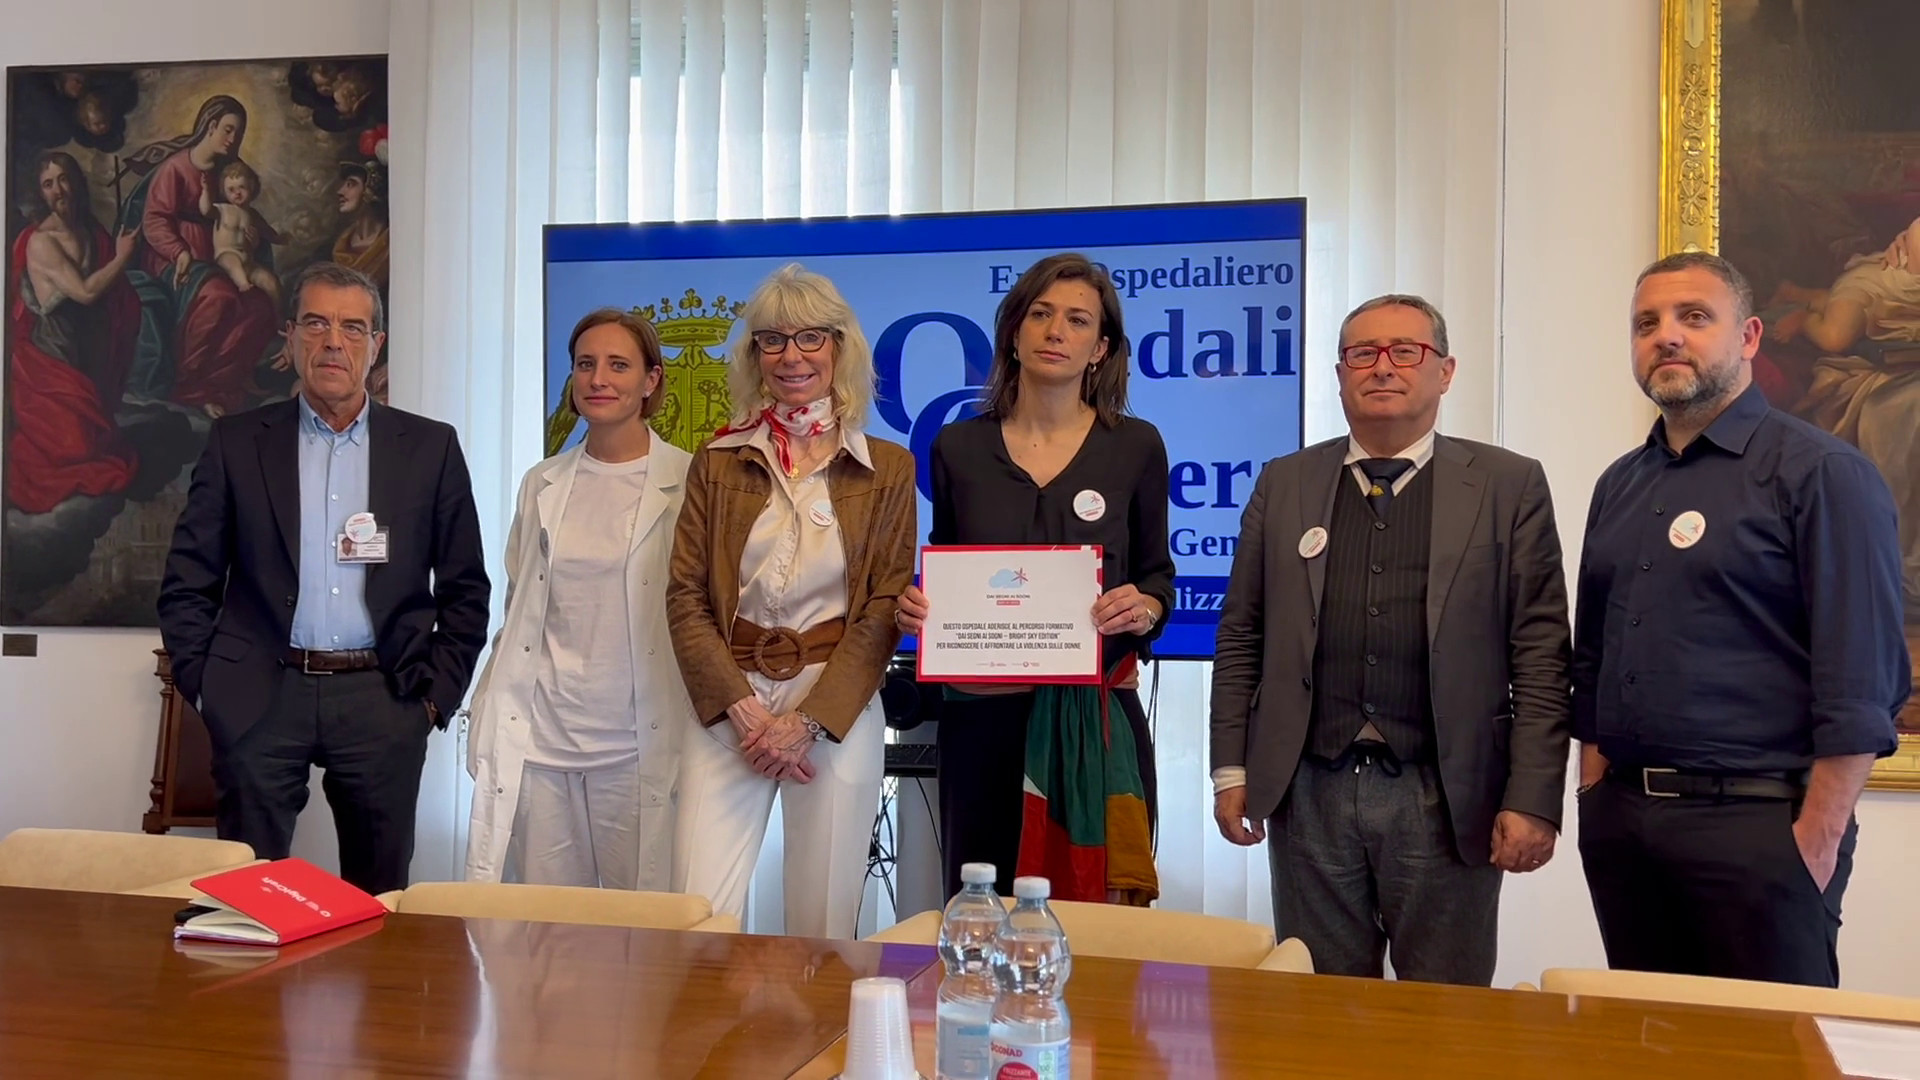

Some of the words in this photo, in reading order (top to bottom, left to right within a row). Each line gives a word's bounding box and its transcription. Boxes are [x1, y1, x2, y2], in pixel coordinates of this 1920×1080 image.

[967, 632, 982, 640] SEGNI
[982, 632, 988, 640] AI
[988, 632, 1003, 640] SOGNI
[1009, 632, 1027, 640] BRIGHT
[1027, 632, 1037, 640] SKY
[936, 642, 946, 650] PER
[947, 642, 979, 650] RICONOSCERE
[980, 642, 983, 650] E
[984, 642, 1015, 650] AFFRONTARE
[1016, 642, 1023, 650] LA
[1023, 642, 1048, 650] VIOLENZA
[1048, 642, 1063, 650] SULLE
[1064, 642, 1081, 650] DONNE
